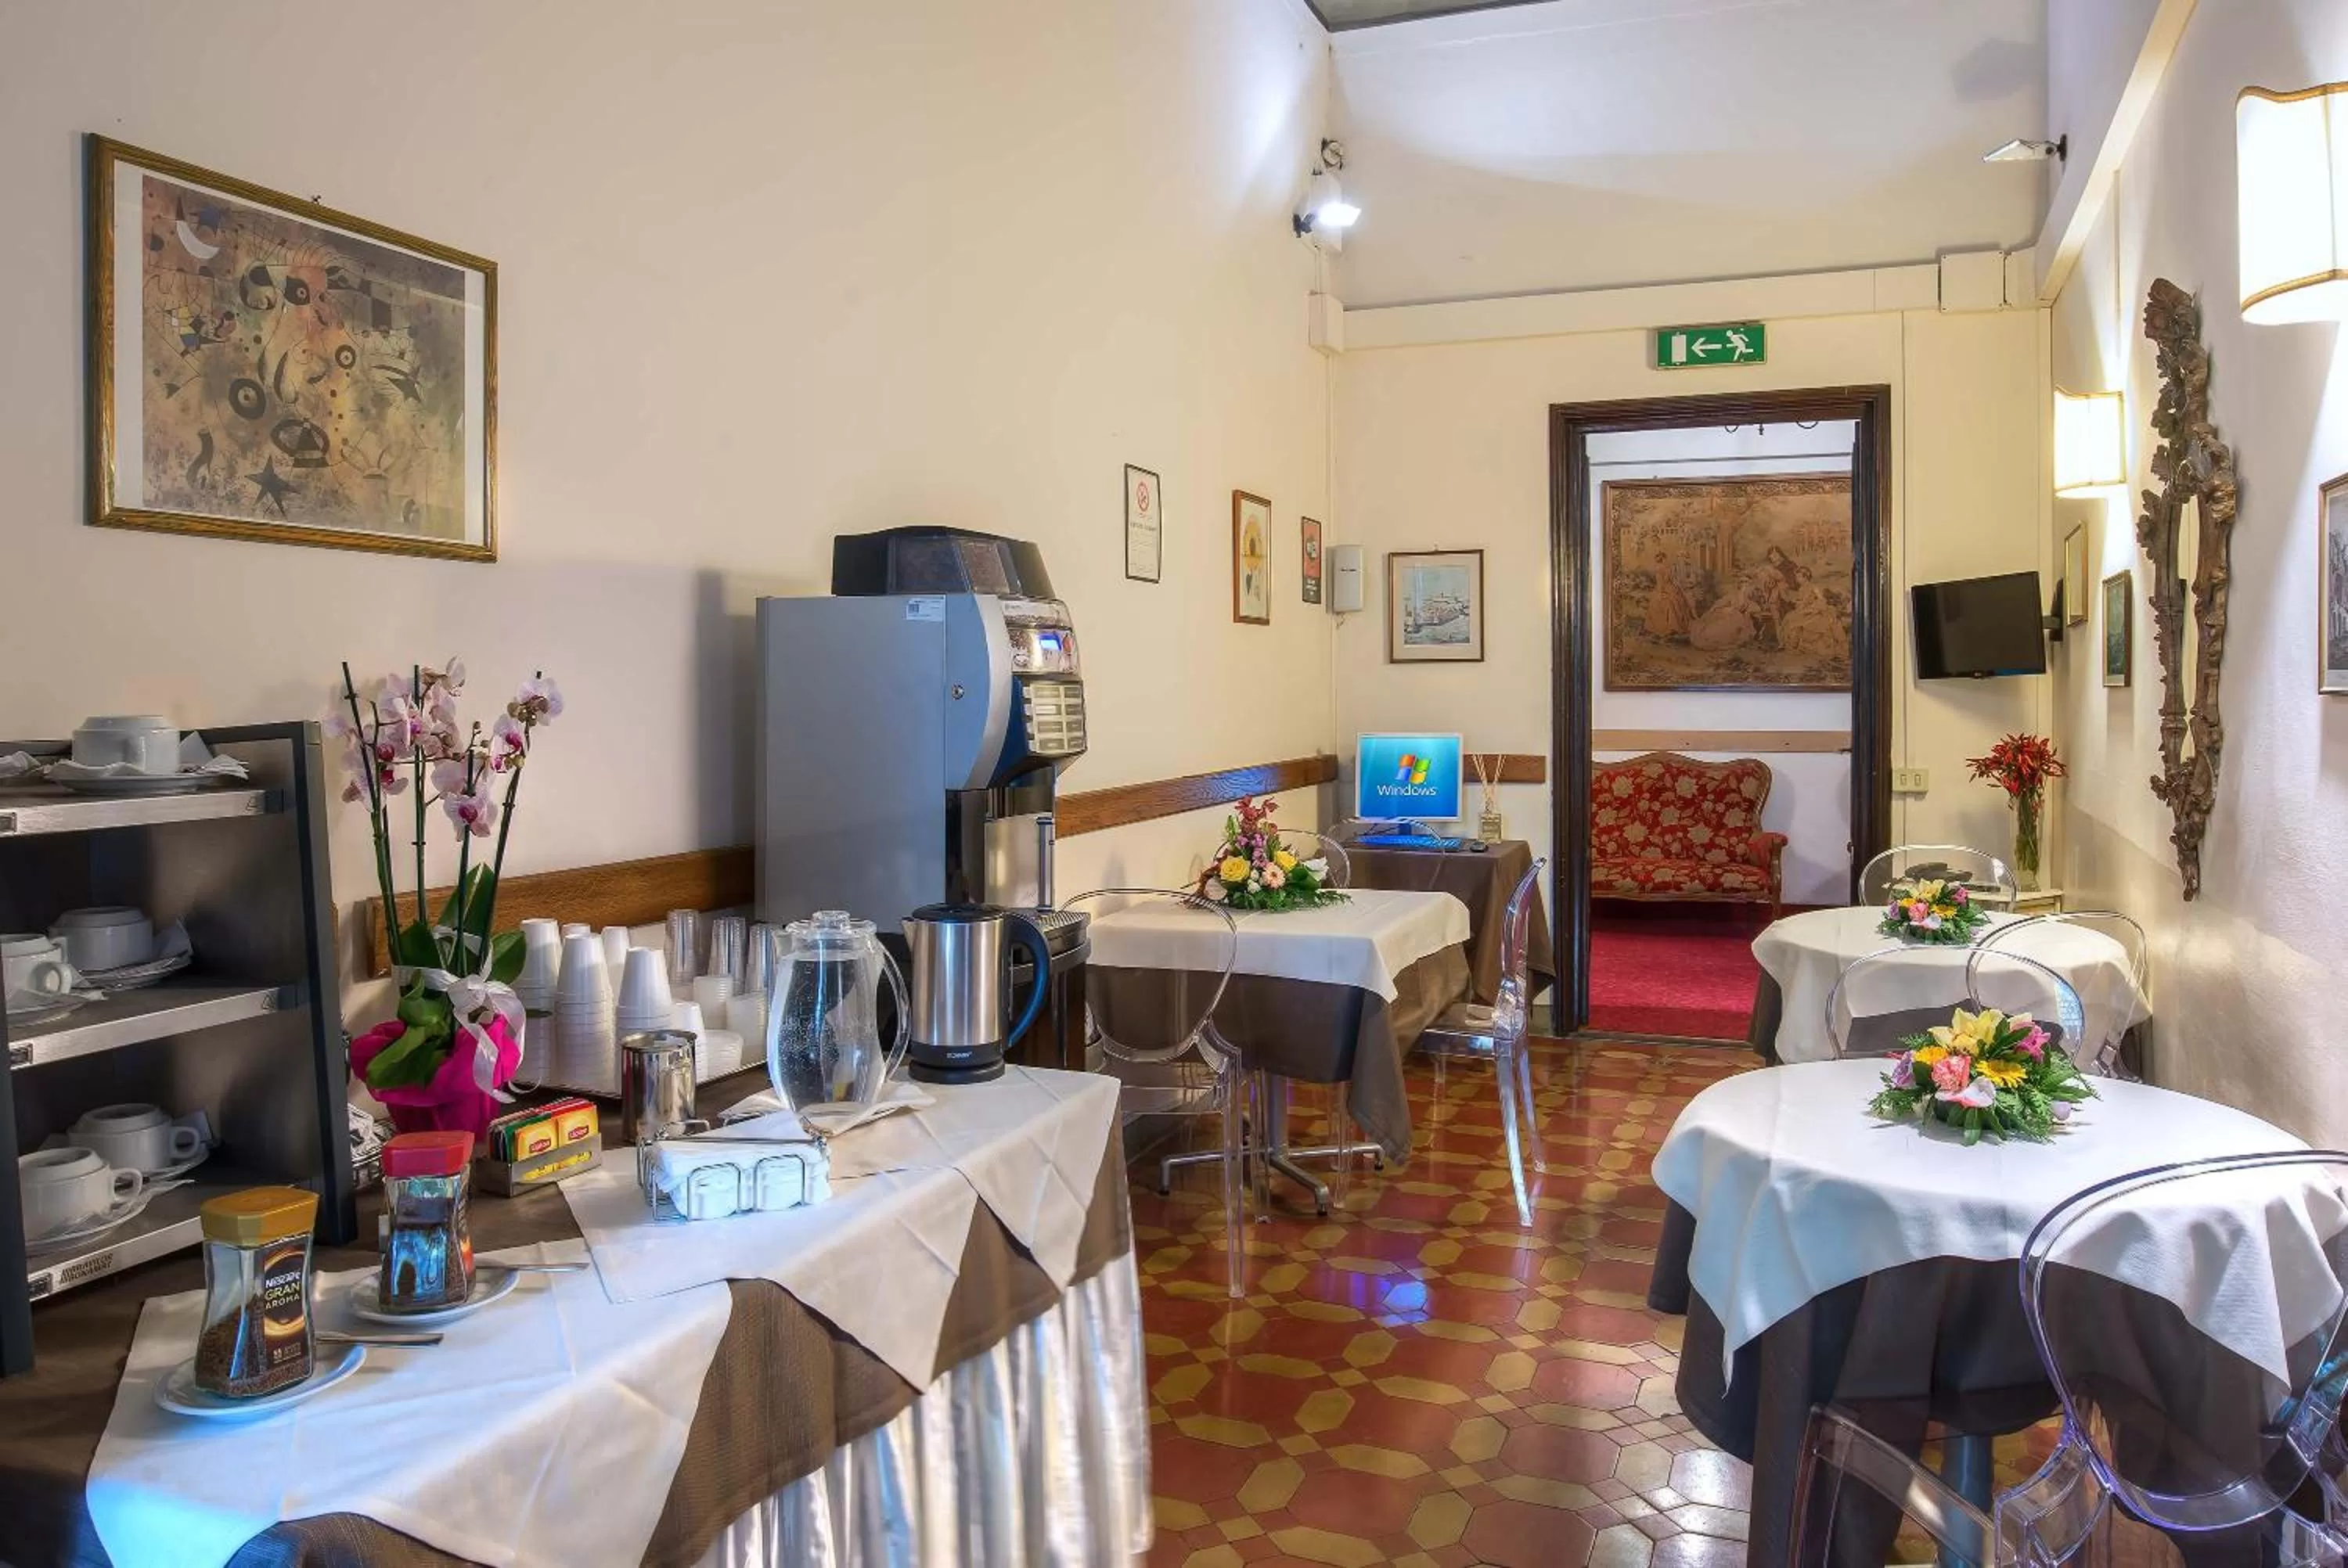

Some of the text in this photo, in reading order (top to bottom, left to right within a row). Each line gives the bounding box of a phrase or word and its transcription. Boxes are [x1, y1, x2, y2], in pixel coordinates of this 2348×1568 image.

[1377, 783, 1437, 796] Windows
[265, 1282, 300, 1300] GRAN
[265, 1294, 300, 1309] AROMA
